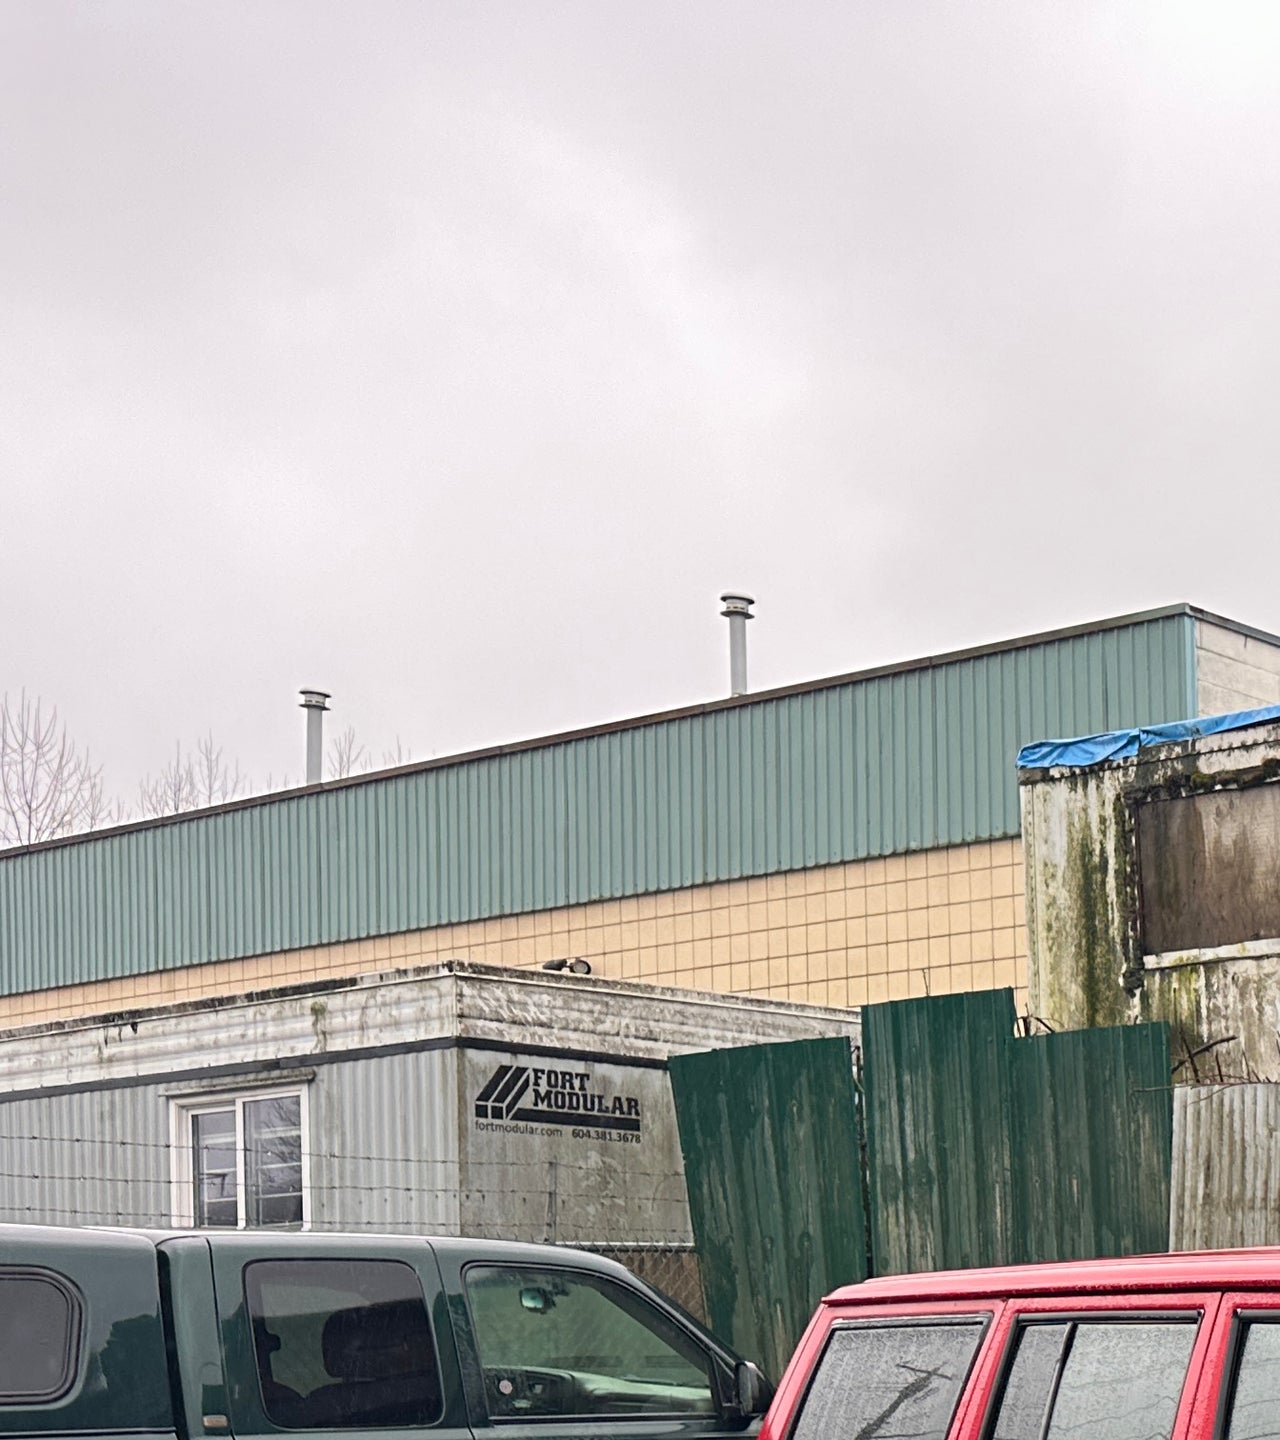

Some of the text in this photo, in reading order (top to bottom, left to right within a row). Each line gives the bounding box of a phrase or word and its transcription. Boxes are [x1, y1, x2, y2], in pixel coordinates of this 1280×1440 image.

[531, 1068, 590, 1091] FORT
[531, 1088, 641, 1117] MODULAR
[475, 1119, 642, 1145] fortmodular.com 604.381.3678
